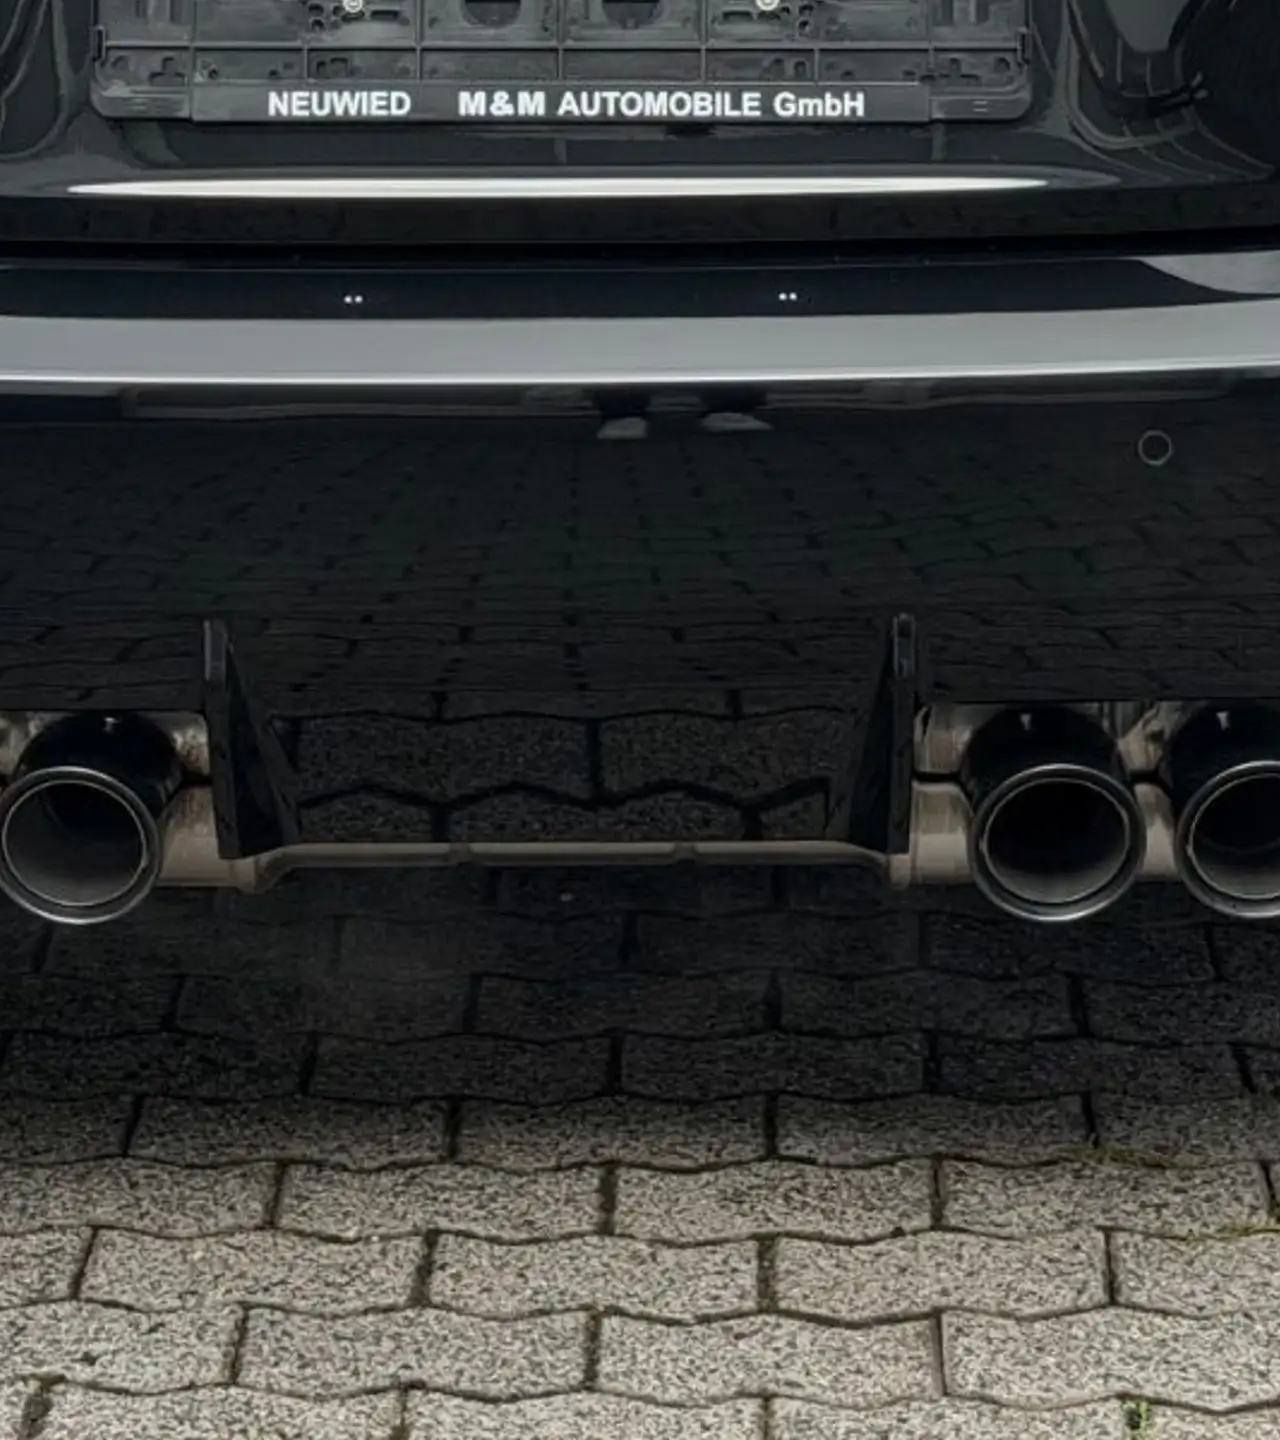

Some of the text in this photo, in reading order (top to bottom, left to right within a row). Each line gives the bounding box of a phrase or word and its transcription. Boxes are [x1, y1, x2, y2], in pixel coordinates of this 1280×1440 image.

[268, 90, 865, 117] NEUWIED M&M AUTOMOBILE GmbH
